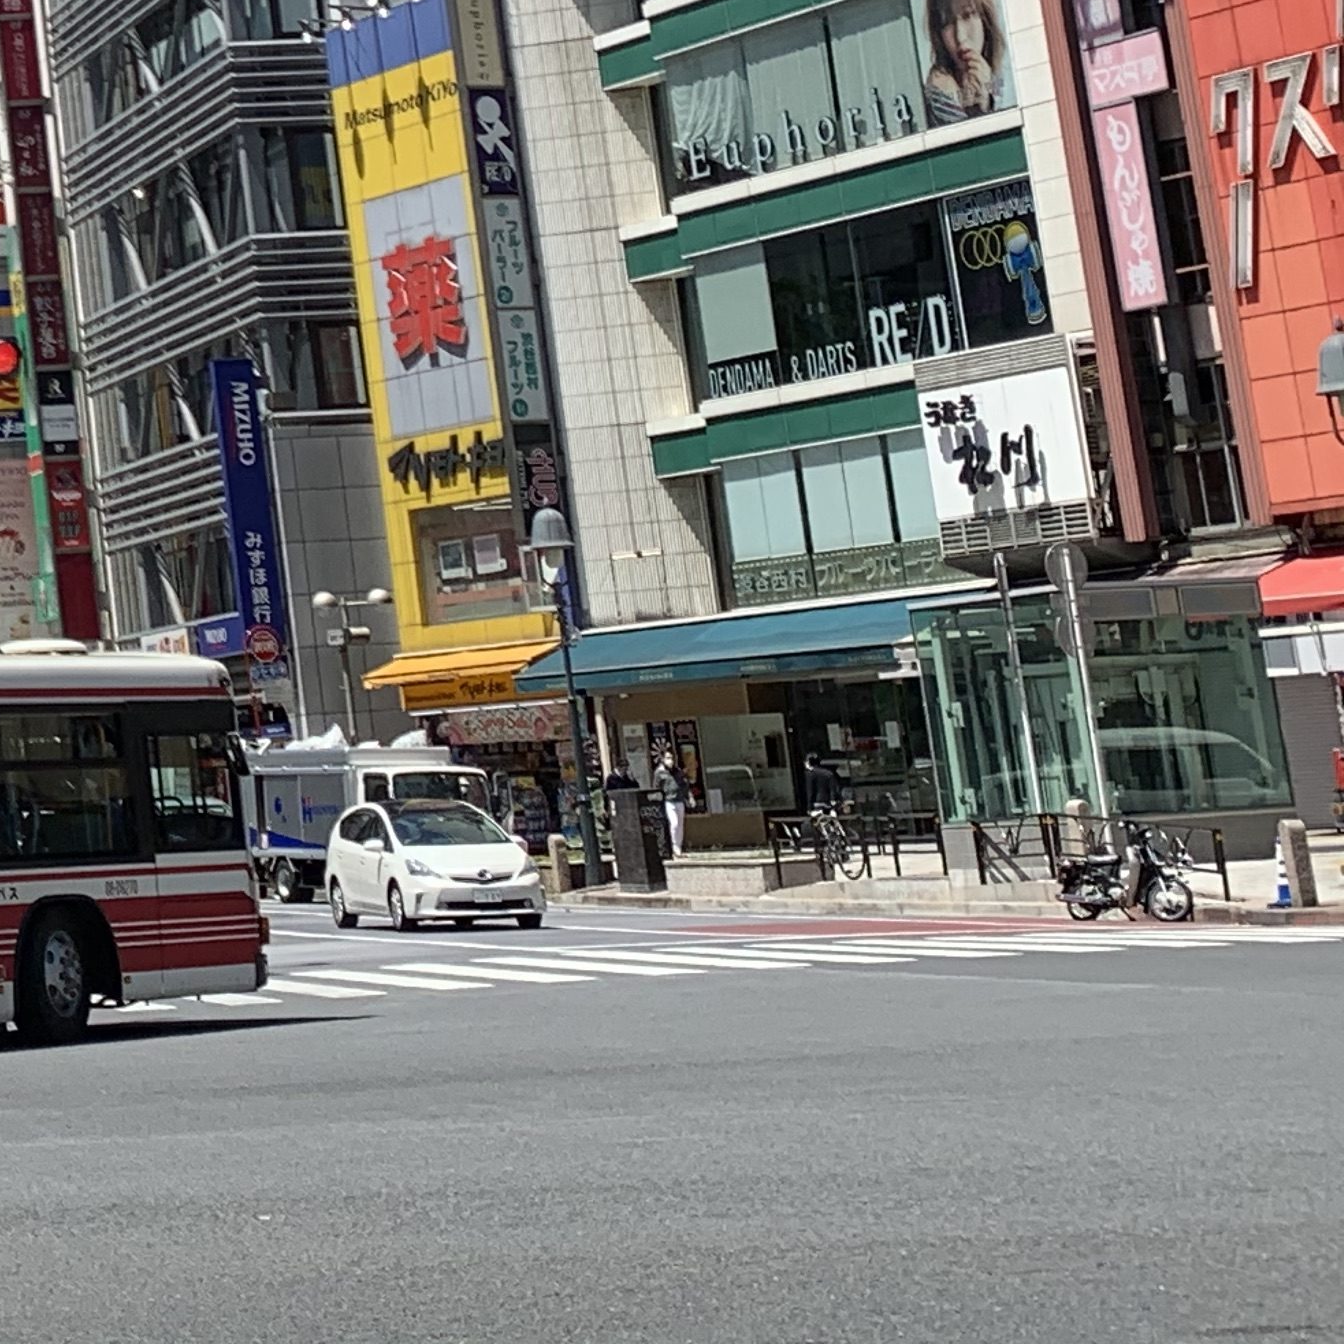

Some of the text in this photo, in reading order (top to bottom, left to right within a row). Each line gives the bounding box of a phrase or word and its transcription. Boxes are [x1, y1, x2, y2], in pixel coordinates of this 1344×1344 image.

[344, 79, 458, 131] Matsumoto KiYo
[686, 87, 914, 182] Euphoria
[380, 235, 469, 369] 薬
[709, 293, 952, 398] DENDAMA & DARTS RE/D
[229, 381, 257, 467] MIZUHO
[244, 530, 272, 624] みずほ銀行
